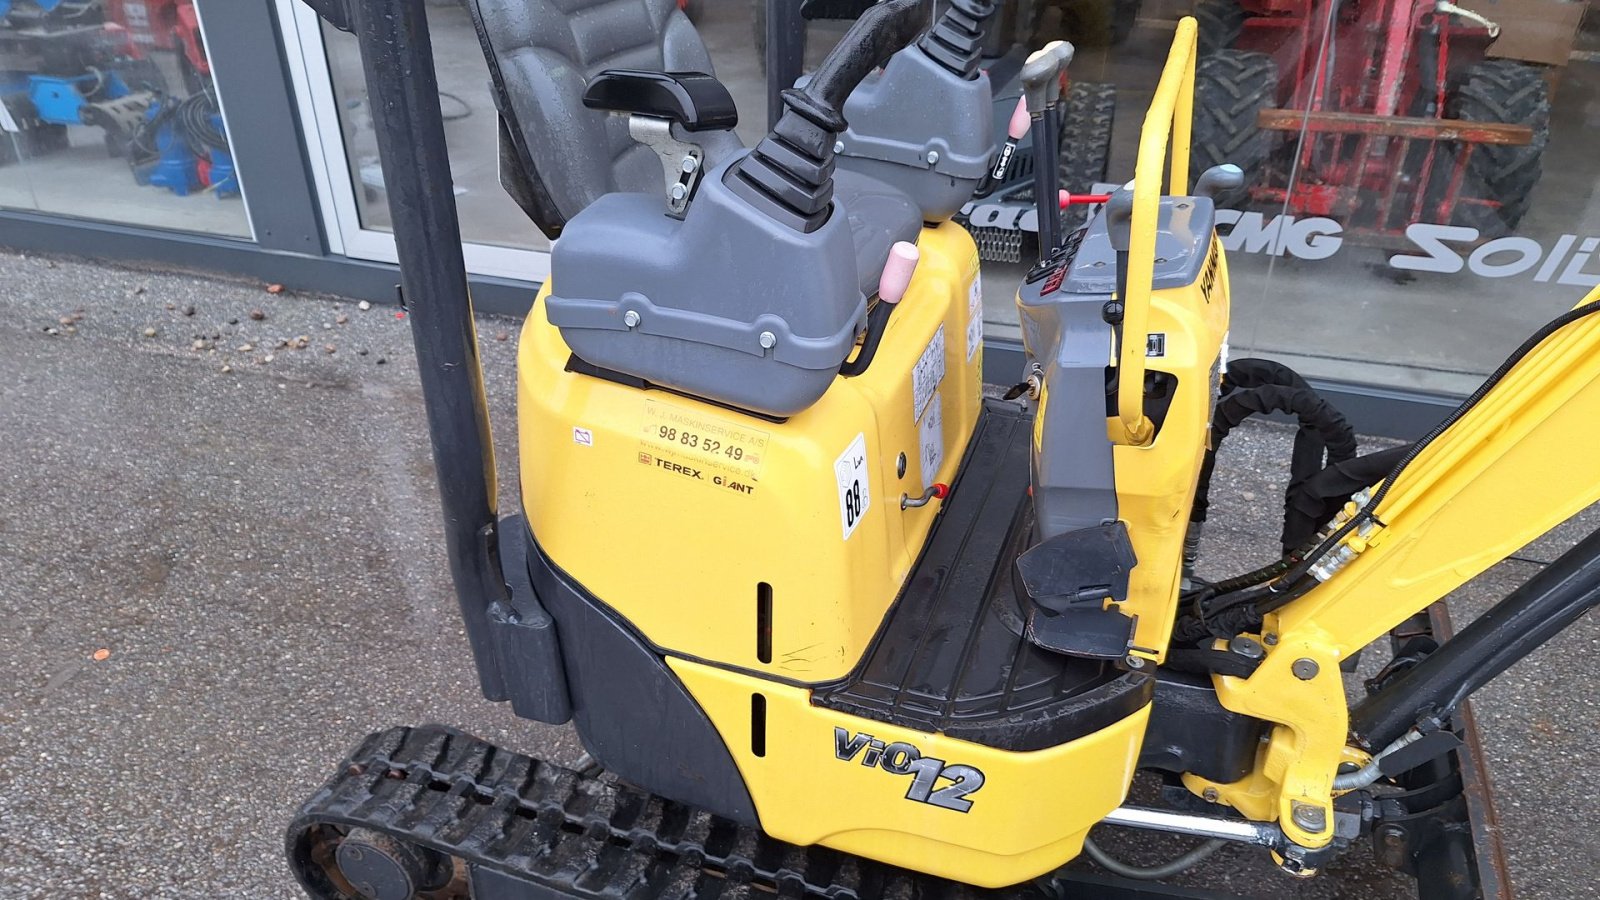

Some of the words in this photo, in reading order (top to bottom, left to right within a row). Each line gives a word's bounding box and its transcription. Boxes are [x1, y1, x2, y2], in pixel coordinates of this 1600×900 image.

[1389, 222, 1600, 287] Soli
[658, 425, 677, 441] 98
[680, 431, 699, 448] 83
[702, 438, 721, 455] 52
[724, 445, 744, 461] 49
[669, 412, 747, 443] MASKINSERVICE
[655, 457, 702, 480] TEREX
[845, 479, 861, 528] 88
